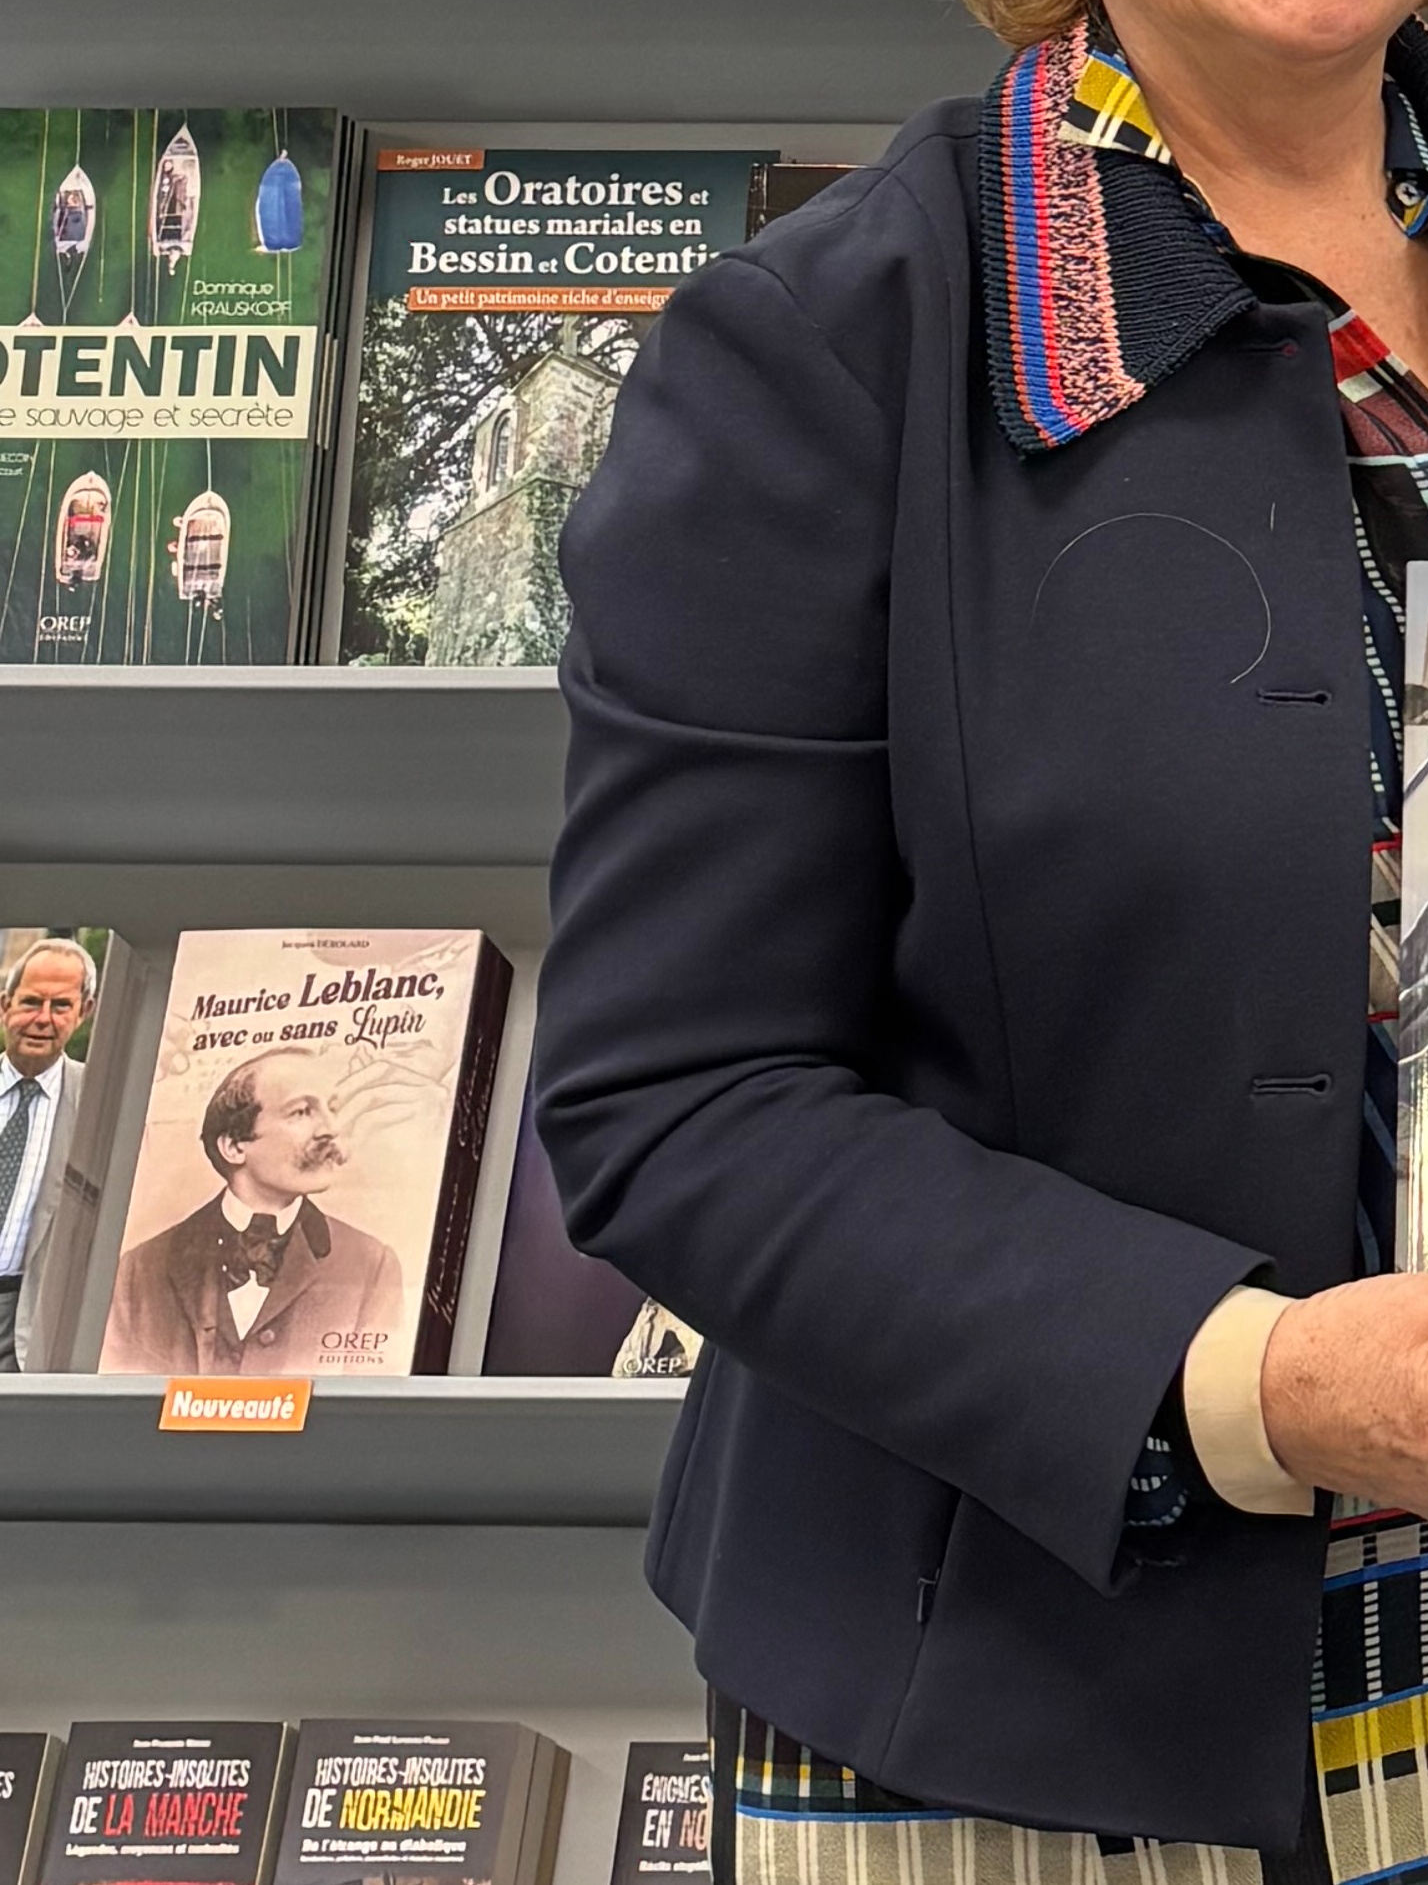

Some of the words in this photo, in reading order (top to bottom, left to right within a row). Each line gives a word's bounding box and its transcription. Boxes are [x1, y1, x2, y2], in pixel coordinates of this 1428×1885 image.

[442, 187, 478, 206] Les
[484, 170, 684, 207] Oratoires
[689, 190, 709, 206] et
[444, 213, 541, 236] statues
[546, 210, 663, 236] mariales
[669, 217, 702, 236] en
[408, 241, 534, 274] Bessin
[538, 257, 559, 274] et
[564, 241, 721, 275] Cotenti
[193, 280, 275, 300] Dominique
[416, 290, 437, 306] Un
[440, 289, 476, 309] petit
[478, 289, 558, 309] patrimoine
[562, 288, 599, 306] riche
[191, 300, 293, 317] KRAUSKOPF
[26, 407, 144, 434] sauvage
[153, 403, 180, 428] et
[189, 401, 294, 428] secrète
[40, 616, 92, 633] OREP
[191, 988, 291, 1021] Maurice
[298, 968, 445, 1008] Leblanc,
[192, 1027, 248, 1051] avec
[252, 1031, 274, 1045] ou
[280, 1020, 338, 1041] sans
[344, 1004, 426, 1049] Lupin
[321, 1331, 389, 1351] OREP
[318, 1354, 385, 1364] EDITIONS
[623, 1357, 681, 1374] OREP
[171, 1390, 295, 1419] Nouveauté
[69, 1796, 102, 1834] DE
[104, 1792, 134, 1836] LA
[144, 1790, 248, 1837] MANCHE
[302, 1788, 337, 1829] DE
[339, 1786, 486, 1831] NORMANDIE
[642, 1808, 674, 1849] EN
